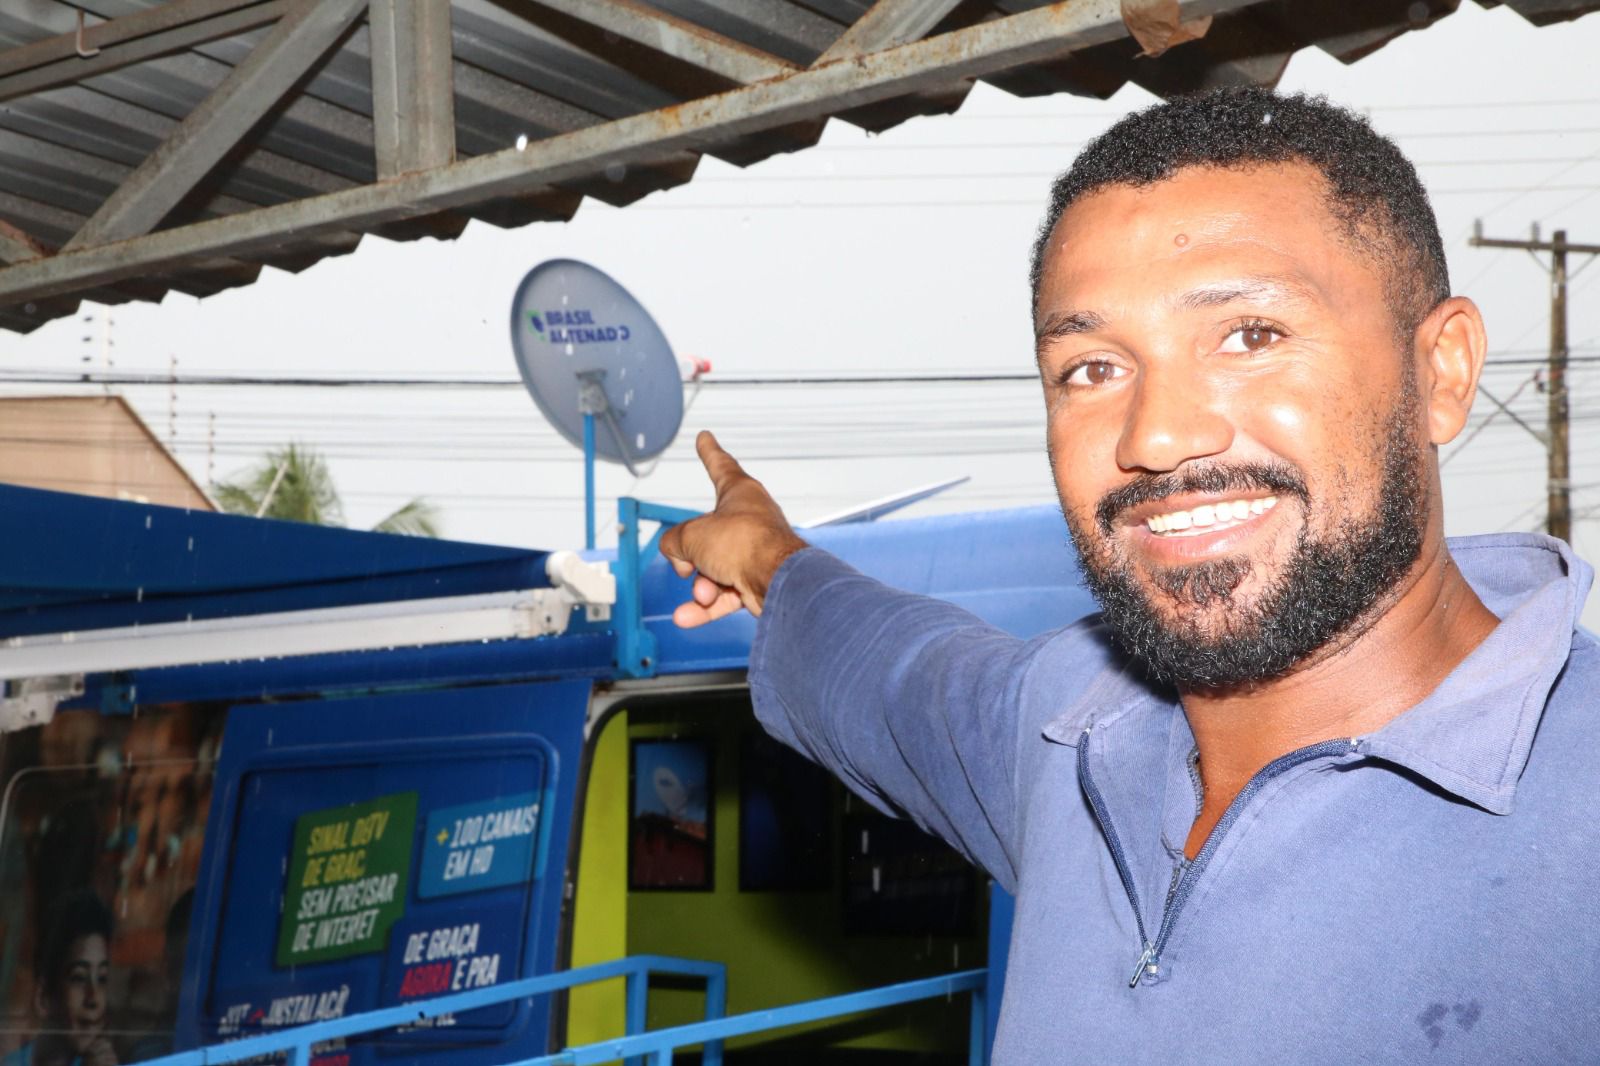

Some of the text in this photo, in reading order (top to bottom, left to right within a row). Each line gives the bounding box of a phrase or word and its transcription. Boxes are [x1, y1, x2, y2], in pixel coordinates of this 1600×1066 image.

[545, 310, 595, 326] BRASIL
[306, 821, 350, 856] SINAL
[449, 815, 484, 849] 100
[480, 803, 540, 843] CANAIS
[302, 856, 327, 888] DE
[443, 844, 496, 881] EM HD
[297, 886, 334, 920] SEM
[291, 921, 317, 953] DE
[403, 922, 480, 965] DE GRAÇA
[399, 959, 453, 998] AGORA
[464, 953, 500, 989] PRA
